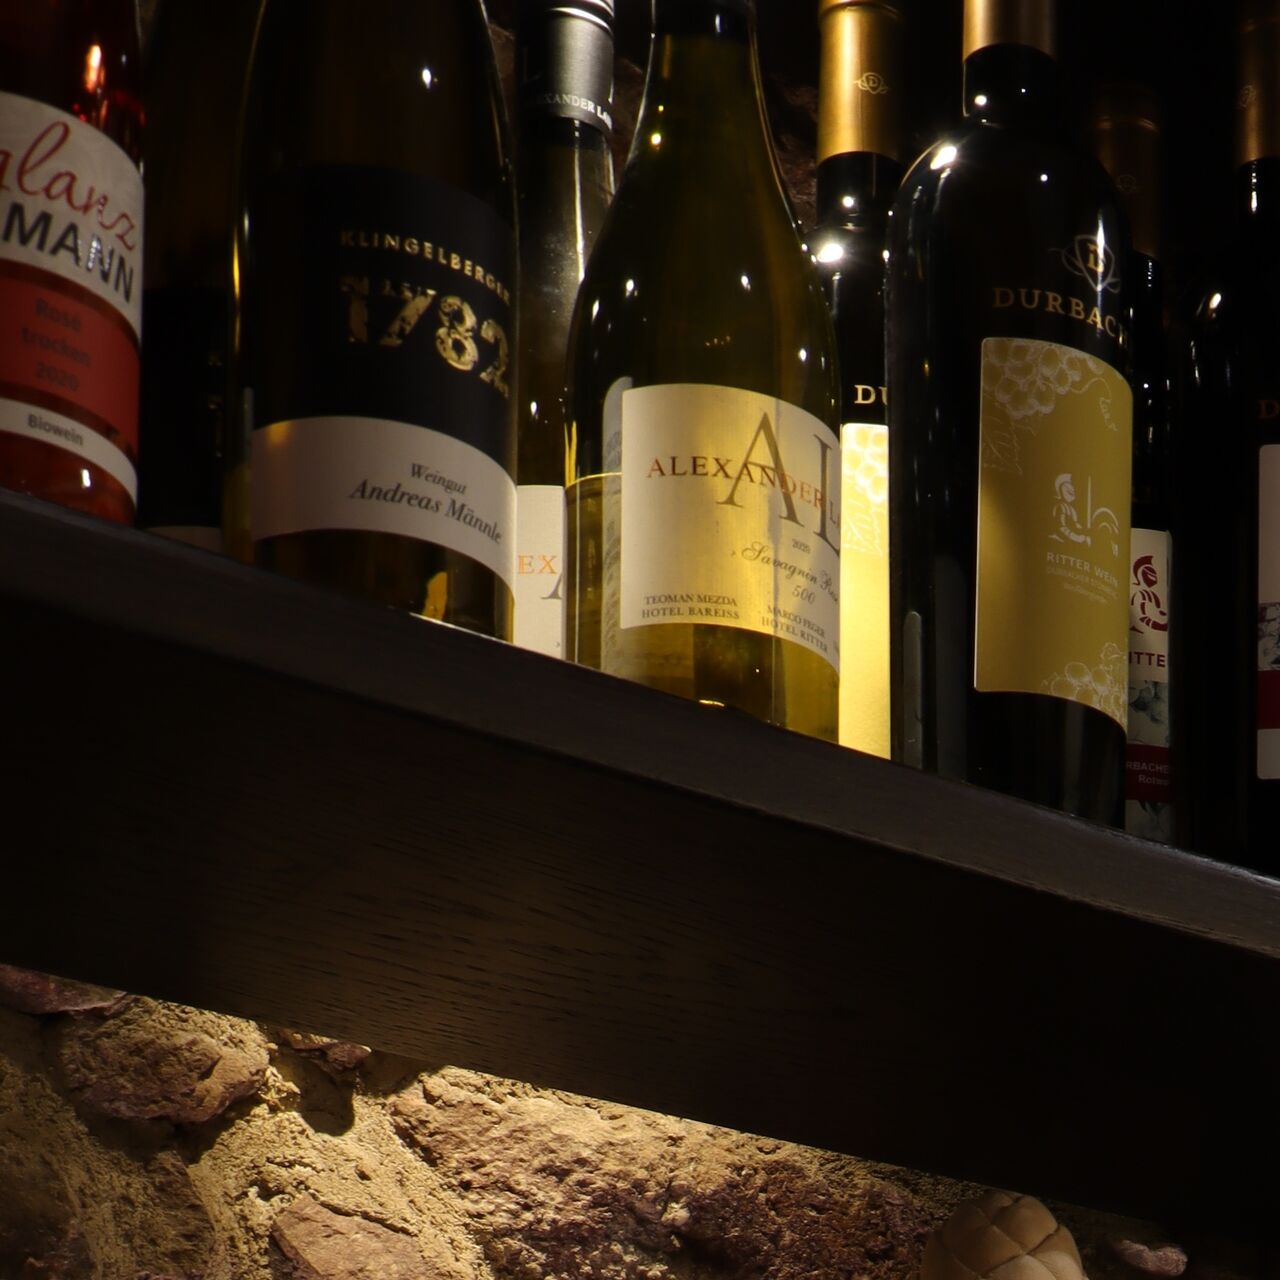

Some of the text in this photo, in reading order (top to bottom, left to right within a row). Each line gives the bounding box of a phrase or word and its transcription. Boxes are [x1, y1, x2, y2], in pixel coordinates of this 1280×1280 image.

[337, 273, 510, 401] 1782
[27, 413, 85, 448] Biowein
[410, 463, 468, 497] Weingut
[647, 455, 824, 510] ALEXANDER
[349, 478, 504, 546] Andreas Männle
[1046, 551, 1092, 574] RITTER
[1094, 568, 1119, 589] WEIN
[641, 606, 740, 620] HOTEL BAREISS
[643, 593, 738, 607] TEOMAN MEZDA
[761, 615, 798, 635] HOTEL
